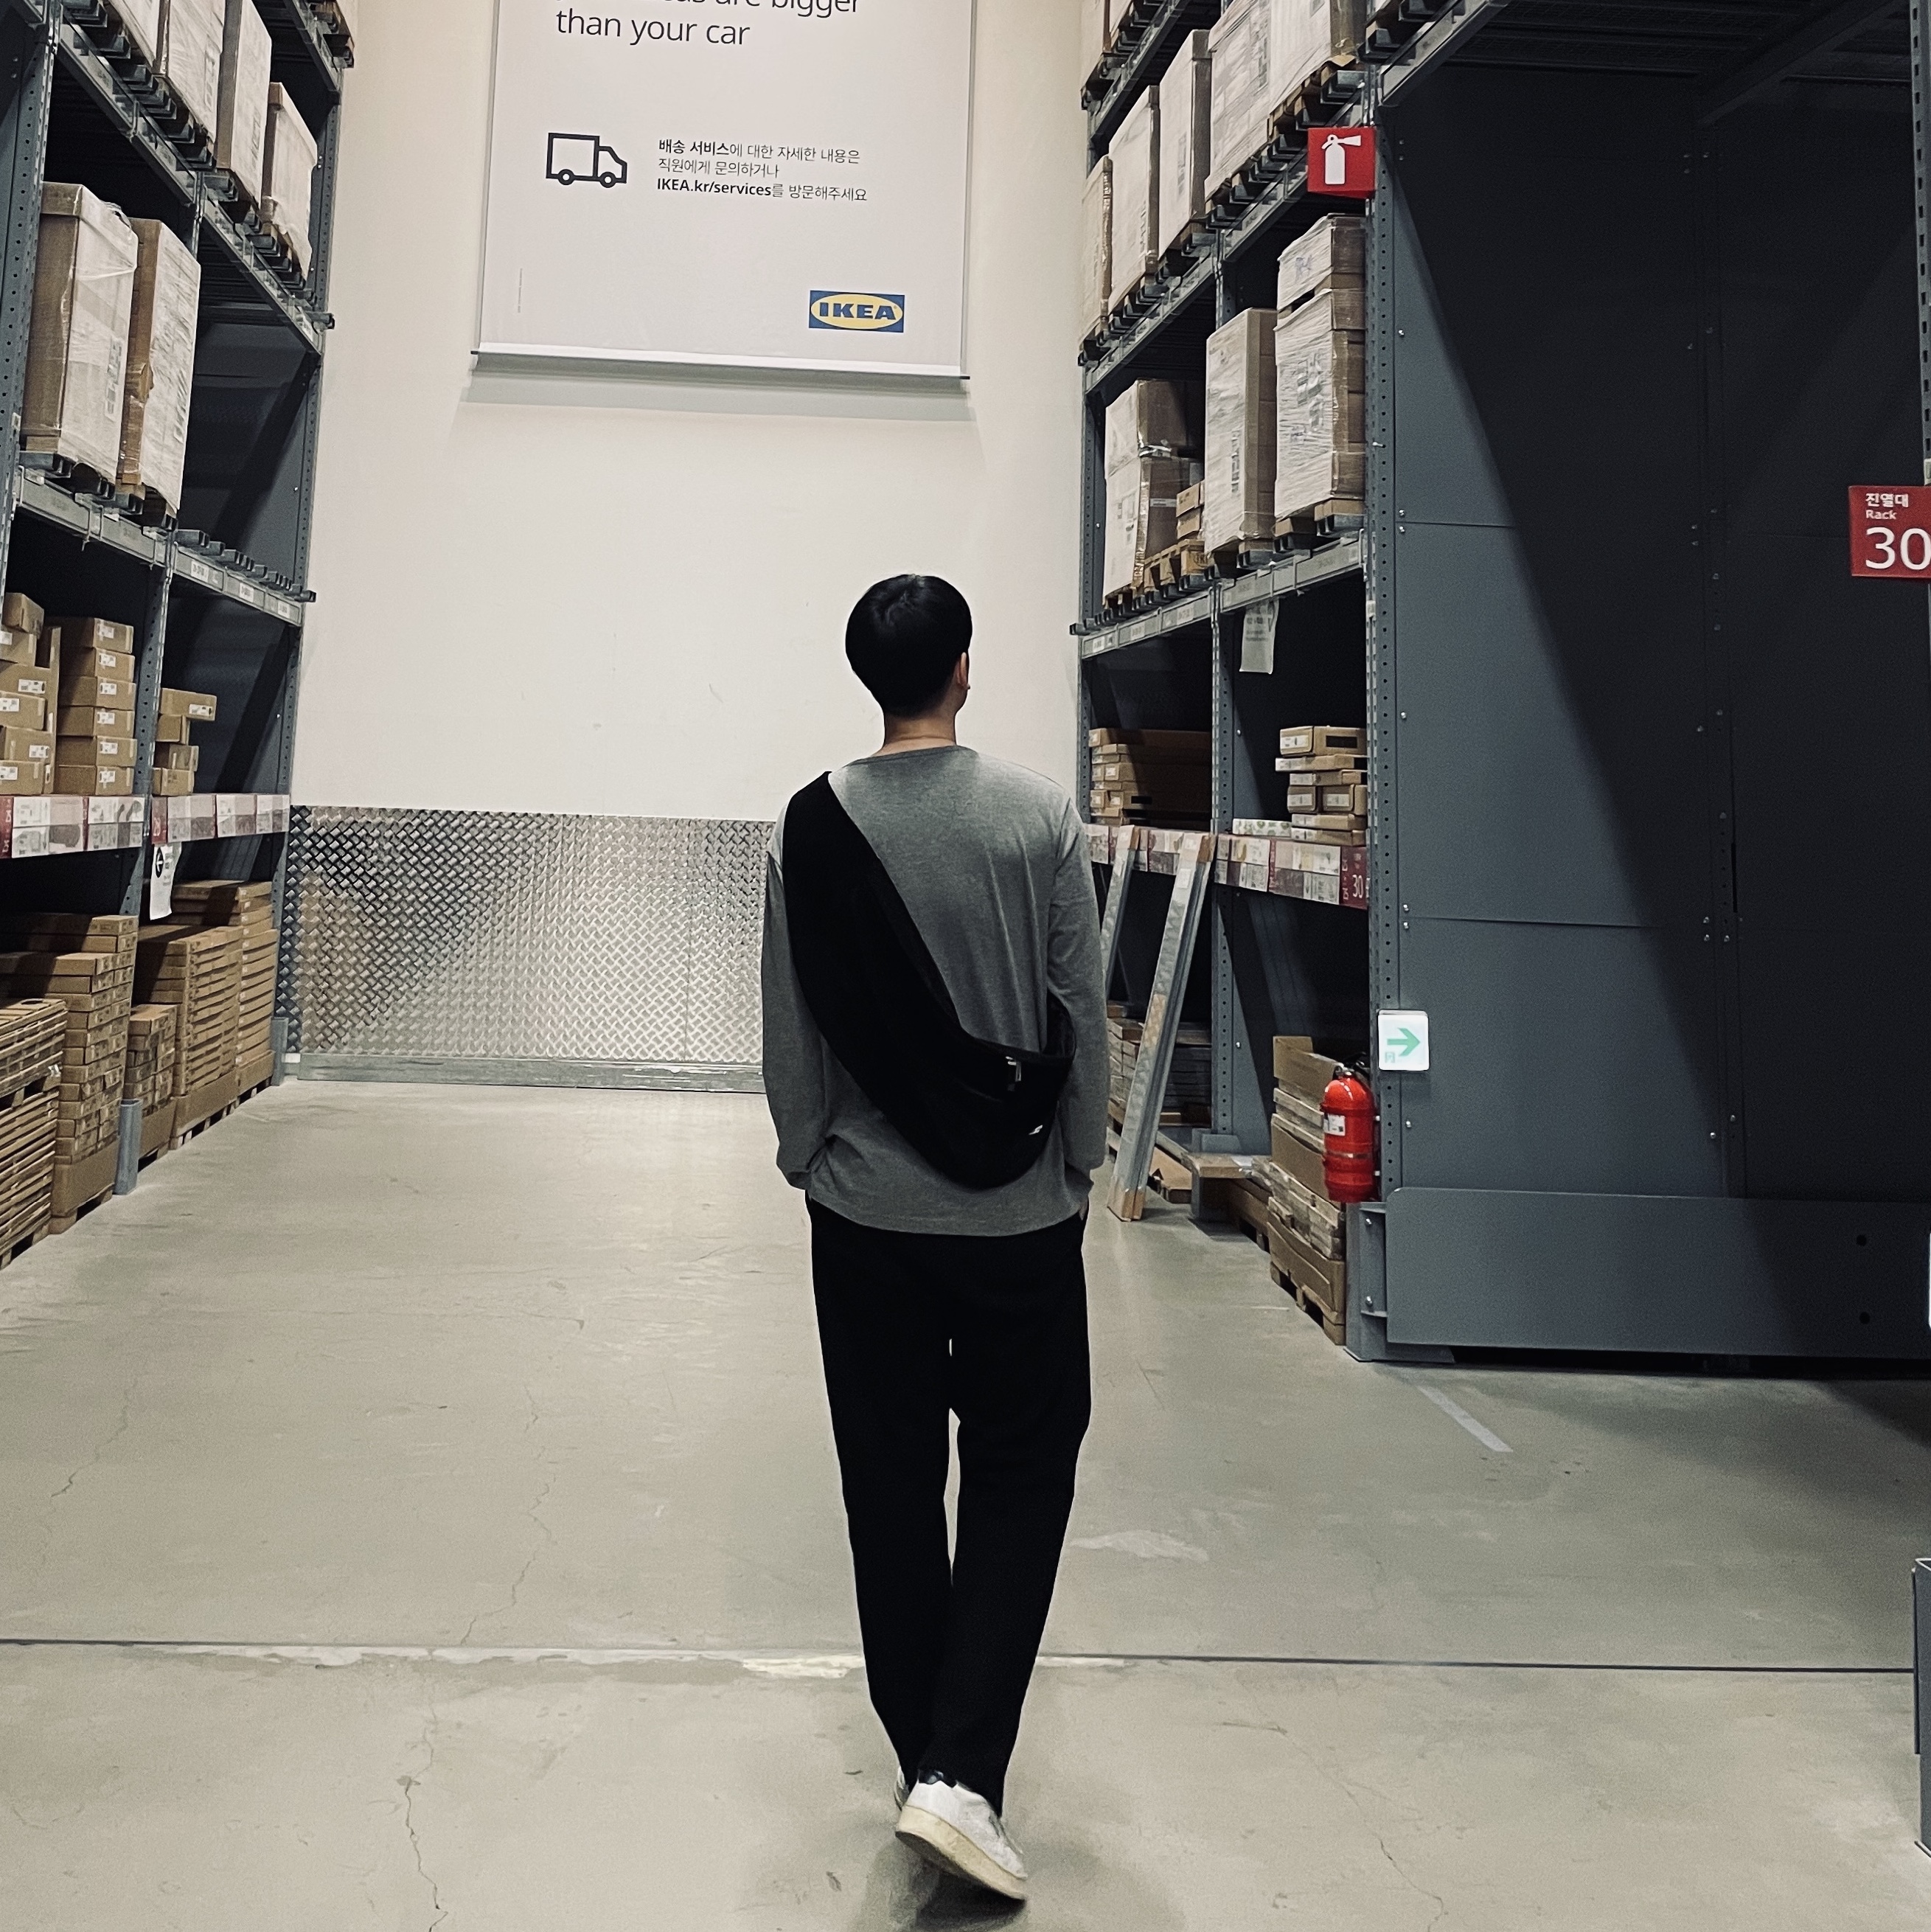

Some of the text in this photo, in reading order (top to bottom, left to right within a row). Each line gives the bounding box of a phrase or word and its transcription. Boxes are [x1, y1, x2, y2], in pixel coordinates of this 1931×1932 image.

[556, 8, 750, 45] than your car
[658, 139, 860, 164] 배송 서비스에 대한 자세한 내용은
[658, 158, 779, 178] 직원에게 문의하거나
[657, 178, 867, 202] IKEA.kr/services를 방문해주세요
[819, 302, 897, 320] IKEA
[1865, 493, 1909, 507] 진열대
[1865, 510, 1897, 520] Rack
[1865, 527, 1931, 570] 30
